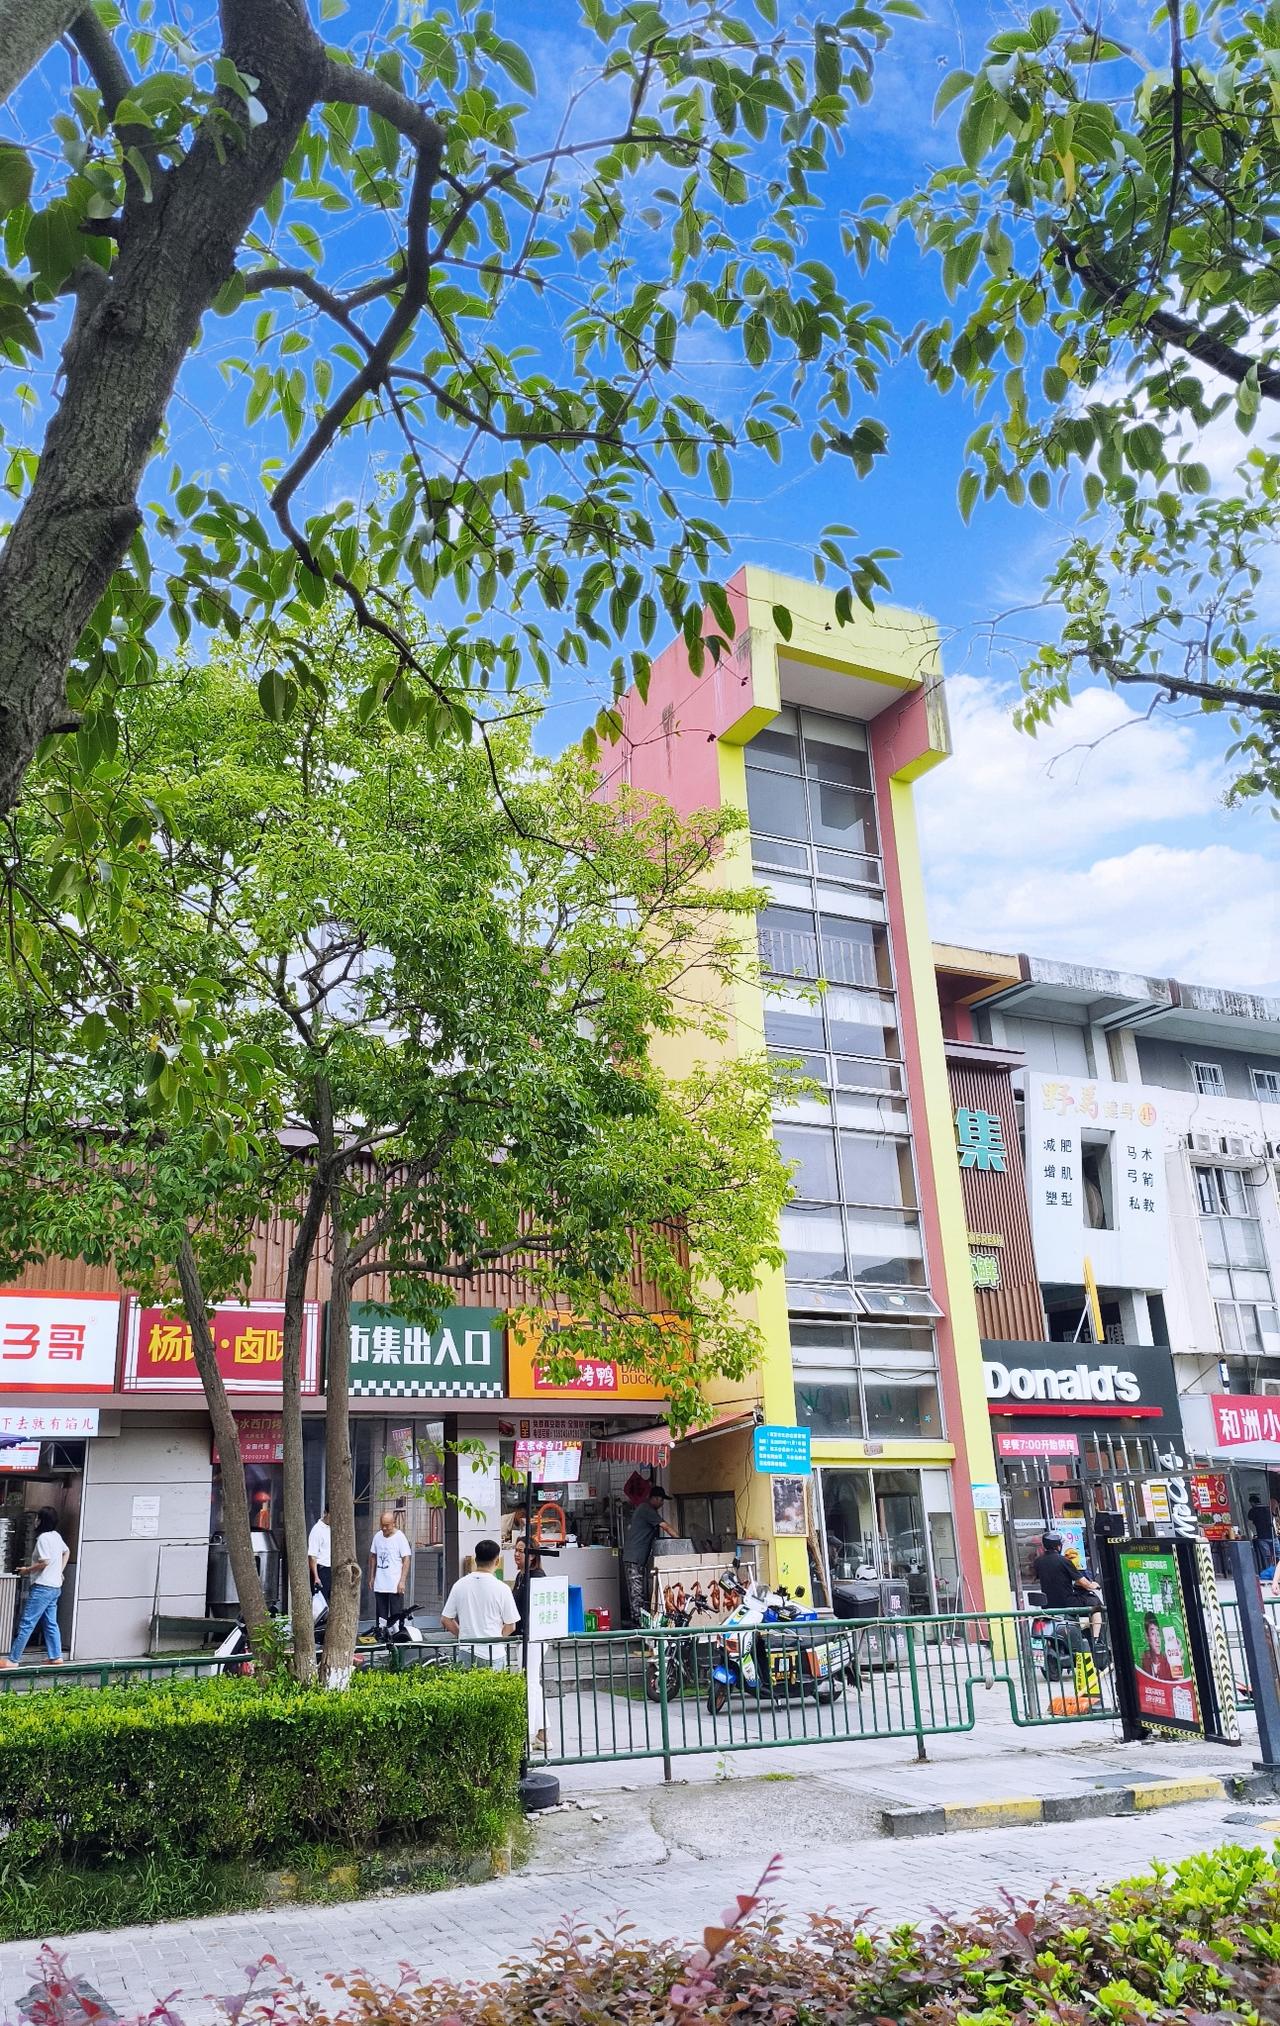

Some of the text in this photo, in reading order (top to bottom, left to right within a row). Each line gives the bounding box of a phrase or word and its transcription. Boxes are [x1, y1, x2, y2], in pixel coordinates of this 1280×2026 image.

[954, 1107, 1007, 1173] 集
[1044, 1138, 1073, 1153] 减肥
[1044, 1165, 1073, 1181] 增肌
[1128, 1169, 1154, 1188] 弓箭
[1046, 1190, 1073, 1207] 塑型
[1129, 1196, 1155, 1213] 私教
[3, 1323, 86, 1361] 子哥
[622, 1374, 653, 1385] DUCK
[3, 1416, 94, 1430] 下去就有馅儿
